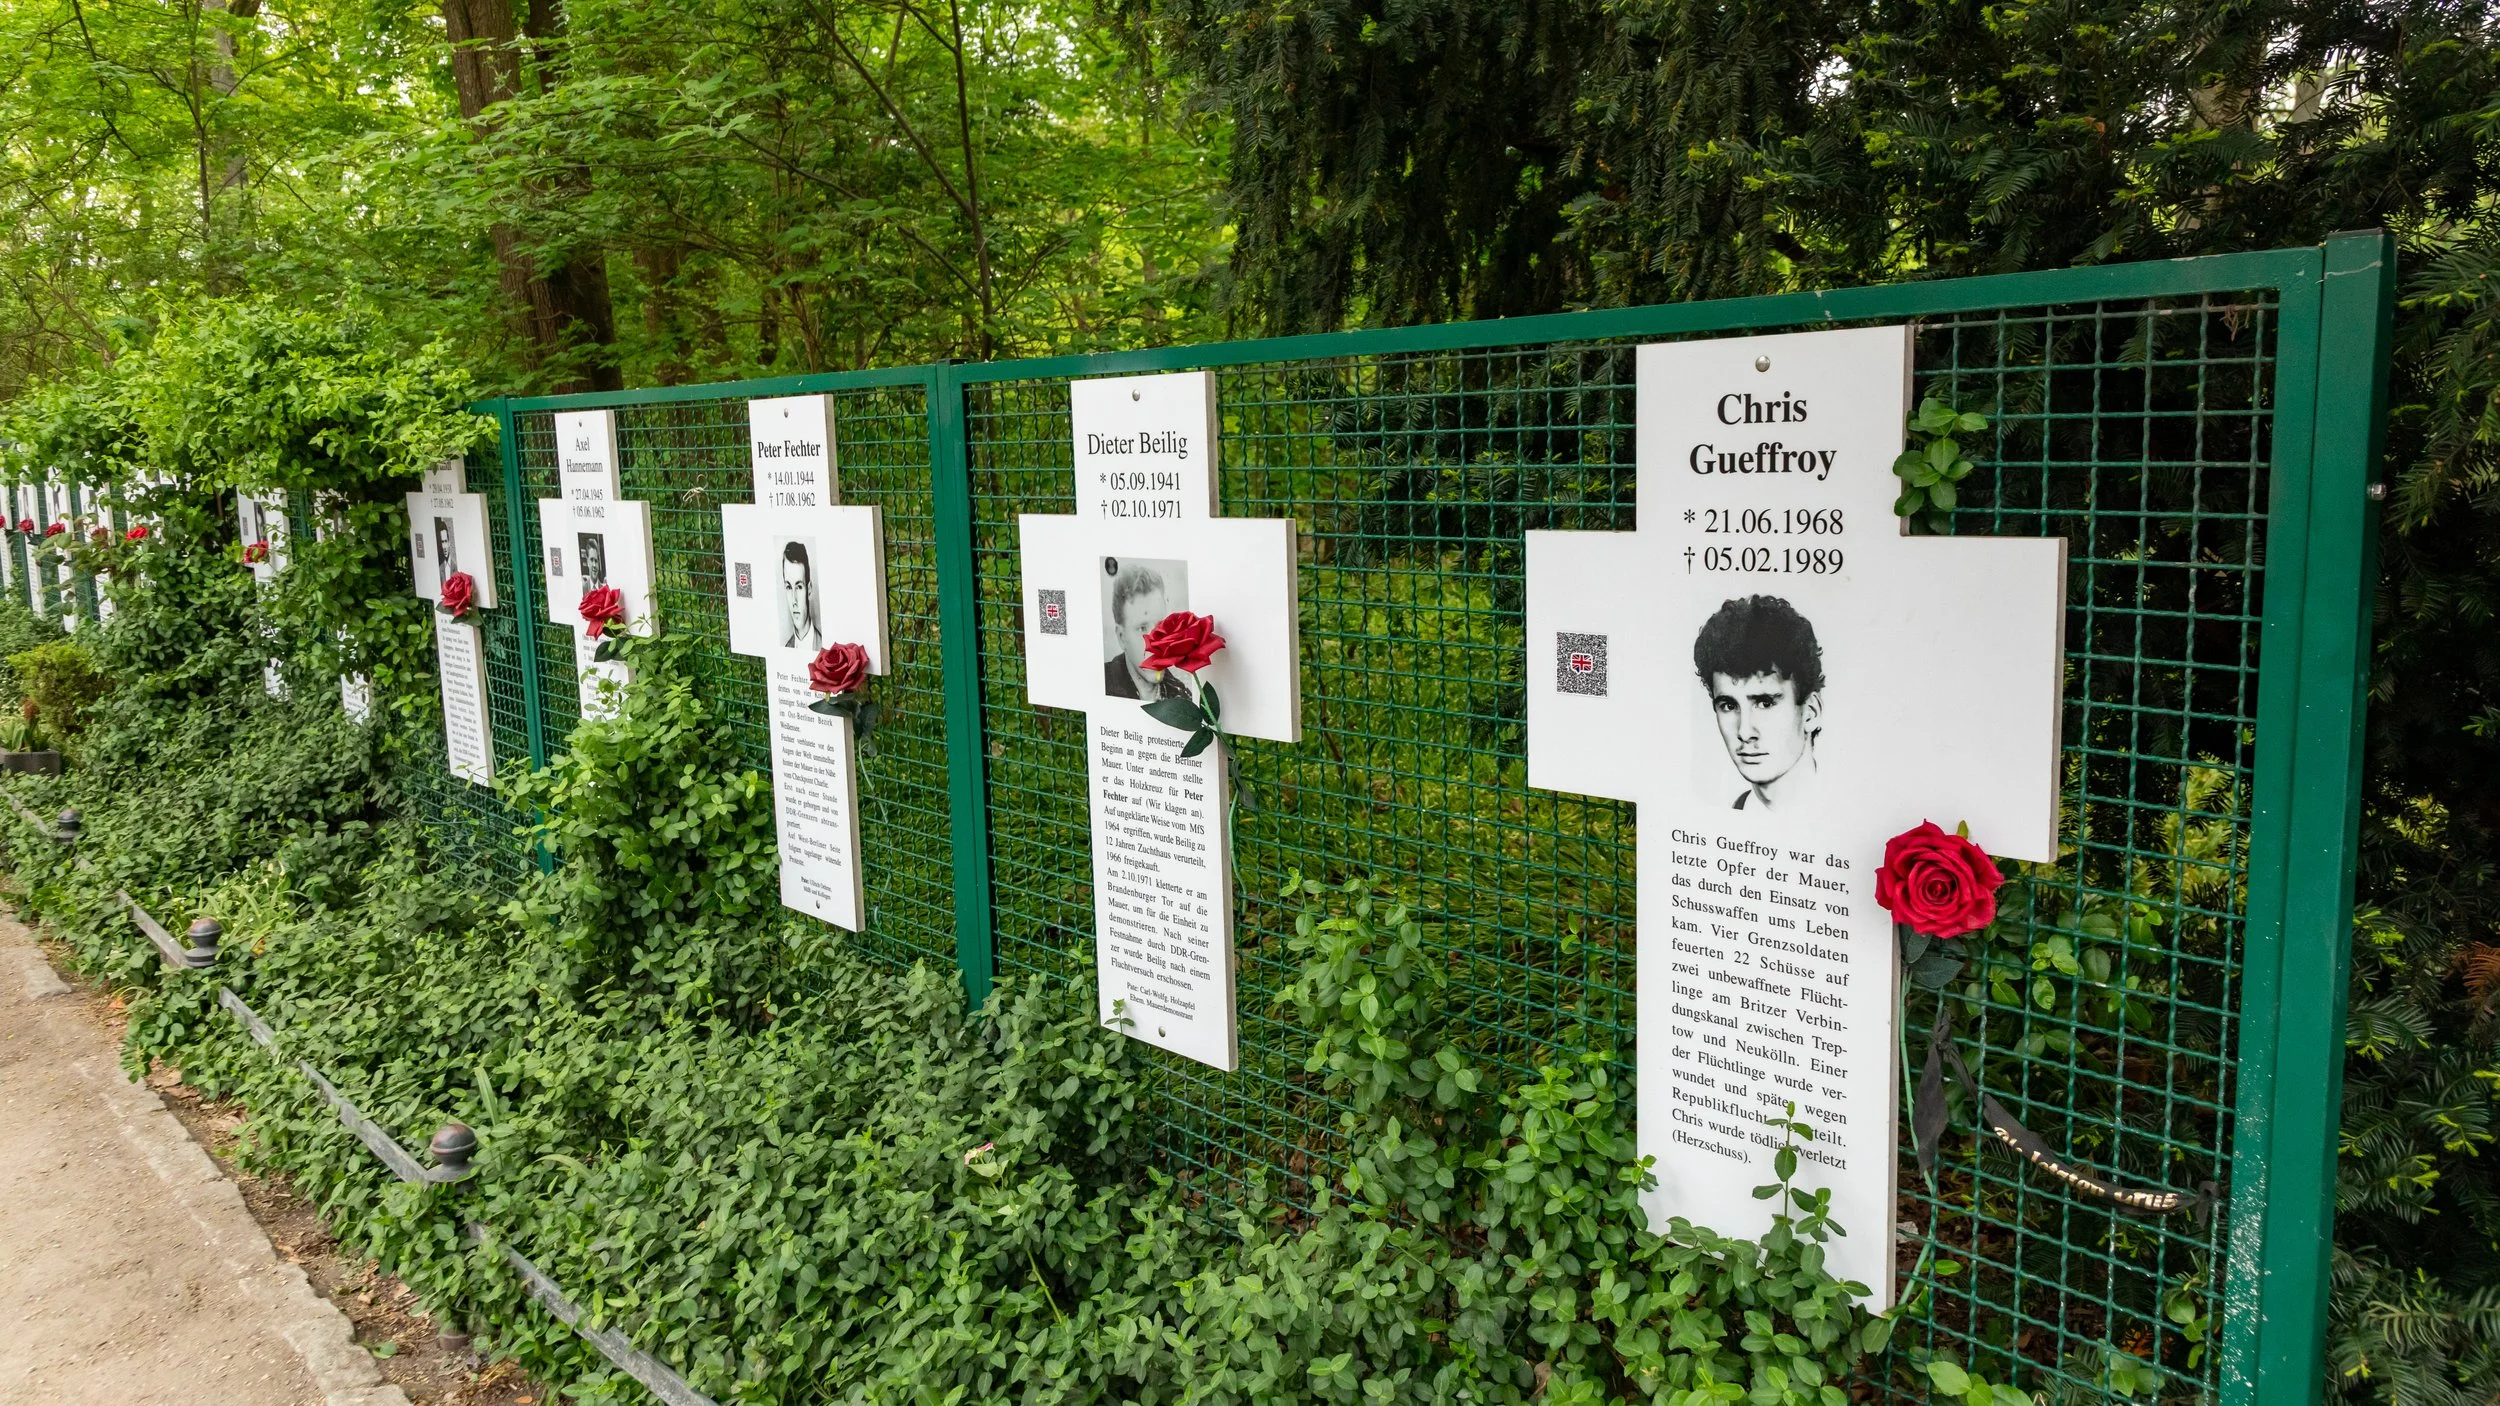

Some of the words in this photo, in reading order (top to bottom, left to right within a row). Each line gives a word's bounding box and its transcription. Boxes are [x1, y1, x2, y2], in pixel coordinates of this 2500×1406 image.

[1717, 391, 1807, 425] Chris
[576, 437, 590, 451] Axel
[758, 442, 781, 458] Peter
[784, 440, 820, 457] Fechter
[1088, 434, 1134, 454] Dieter
[1140, 431, 1188, 459] Beilig
[1690, 442, 1837, 481] Gueffroy
[567, 459, 603, 472] Hannemann
[775, 471, 814, 485] 14.01.1944
[1110, 472, 1180, 490] 05.09.1941
[776, 492, 815, 506] 17.08.1962
[1112, 500, 1181, 518] 02.10.1971
[1704, 509, 1844, 535] 21.06.1968
[1704, 547, 1844, 574] 05.02.1989
[1100, 726, 1120, 738] Dieter
[1123, 729, 1144, 745] Beilig
[1147, 736, 1186, 749] protestierte
[1101, 741, 1123, 755] Beginn
[1126, 748, 1135, 757] an
[1137, 750, 1157, 762] gegen
[1160, 752, 1171, 763] die
[1101, 757, 1124, 770] Mauer.
[1125, 761, 1144, 774] Unter
[1149, 767, 1178, 780] anderem
[1182, 773, 1203, 785] stellte
[1113, 775, 1125, 787] das
[1129, 778, 1163, 794] Holzkreuz
[1168, 785, 1179, 797] für
[1184, 788, 1204, 802] Peter
[1103, 789, 1129, 803] Fechter
[1131, 796, 1143, 806] auf
[1145, 798, 1161, 810] (Wir
[1164, 801, 1187, 816] klagen
[1190, 809, 1204, 820] an).
[1104, 805, 1117, 816] Auf
[1116, 810, 1150, 823] ungeklärte
[1150, 814, 1170, 828] Weise
[1171, 821, 1187, 831] vom
[1189, 822, 1205, 835] MfS
[1105, 820, 1120, 832] 1964
[1123, 826, 1153, 840] ergriffen,
[1153, 833, 1174, 845] wurde
[1175, 835, 1196, 852] Beilig
[1196, 843, 1206, 852] zu
[1105, 835, 1113, 846] 12
[1115, 837, 1136, 852] Jahren
[1137, 842, 1172, 860] Zuchthaus
[1173, 853, 1206, 869] verurteilt,
[1671, 829, 1707, 846] Chris
[1716, 836, 1778, 861] Gueffroy
[1789, 851, 1816, 864] war
[1825, 853, 1850, 870] das
[1106, 851, 1122, 863] 1966
[1123, 855, 1160, 873] freigekauft.
[1672, 850, 1707, 869] letzte
[1717, 858, 1756, 877] Opfer
[1766, 867, 1789, 883] der
[1798, 872, 1849, 895] Mauer,
[1106, 867, 1119, 878] Am
[1121, 869, 1152, 887] 2.10.1971
[1155, 878, 1183, 894] kletterte
[1185, 888, 1193, 897] er
[1196, 891, 1208, 901] am
[1107, 881, 1157, 904] Brandenburger
[1161, 895, 1174, 908] Tor
[1179, 902, 1191, 912] auf
[1196, 905, 1208, 917] die
[1671, 873, 1691, 888] das
[1698, 877, 1732, 895] durch
[1739, 885, 1762, 901] den
[1769, 889, 1817, 911] Einsatz
[1825, 903, 1849, 917] von
[1108, 896, 1130, 912] Mauer,
[1132, 906, 1144, 915] um
[1146, 907, 1156, 918] für
[1158, 910, 1170, 922] die
[1172, 914, 1197, 930] Einheit
[1200, 924, 1209, 933] zu
[1108, 912, 1158, 934] demonstrieren.
[1163, 927, 1182, 941] Nach
[1187, 936, 1209, 949] seiner
[1672, 894, 1759, 923] Schusswaffen
[1768, 916, 1796, 930] ums
[1806, 919, 1849, 940] Leben
[1109, 926, 1143, 945] Festnahme
[1147, 938, 1166, 952] durch
[1170, 944, 1210, 964] DDR-Gren-
[1672, 915, 1702, 934] kam.
[1710, 923, 1739, 941] Vier
[1748, 931, 1848, 964] Grenzsoldaten
[1110, 944, 1120, 953] zer
[1123, 948, 1143, 960] wurde
[1146, 952, 1167, 970] Beilig
[1170, 962, 1186, 973] nach
[1189, 966, 1211, 981] einem
[1111, 956, 1154, 979] Fluchtversuch
[1156, 973, 1194, 991] erschossen.
[1672, 937, 1724, 960] feuerten
[1734, 950, 1750, 966] 22
[1760, 956, 1815, 979] Schüsse
[1826, 973, 1850, 987] auf
[1672, 962, 1699, 977] zwei
[1708, 970, 1791, 997] unbewaffnete
[1800, 987, 1848, 1009] Flücht-
[1672, 980, 1703, 1001] linge
[1712, 993, 1731, 1006] am
[1740, 996, 1787, 1018] Britzer
[1795, 1008, 1848, 1032] Verbin-
[1671, 1002, 1738, 1029] dungskanal
[1746, 1023, 1804, 1046] zwischen
[1811, 1035, 1847, 1058] Trep-
[1672, 1025, 1694, 1039] tow
[1703, 1034, 1726, 1048] und
[1735, 1038, 1800, 1067] Neukölln.
[1810, 1057, 1848, 1079] Einer
[1671, 1045, 1691, 1060] der
[1697, 1050, 1766, 1082] Flüchtlinge
[1773, 1074, 1813, 1093] wurde
[1821, 1086, 1847, 1100] ver-
[1672, 1068, 1715, 1089] wundet
[1724, 1083, 1747, 1097] und
[1756, 1091, 1788, 1108] späte
[1804, 1104, 1847, 1125] wegen
[1672, 1086, 1768, 1125] Republikflucht
[1672, 1108, 1703, 1127] Chris
[1708, 1121, 1745, 1140] wurde
[1750, 1132, 1789, 1150] tödlic
[1799, 1146, 1846, 1170] verletzt
[1672, 1129, 1751, 1164] (Herzschuss).
